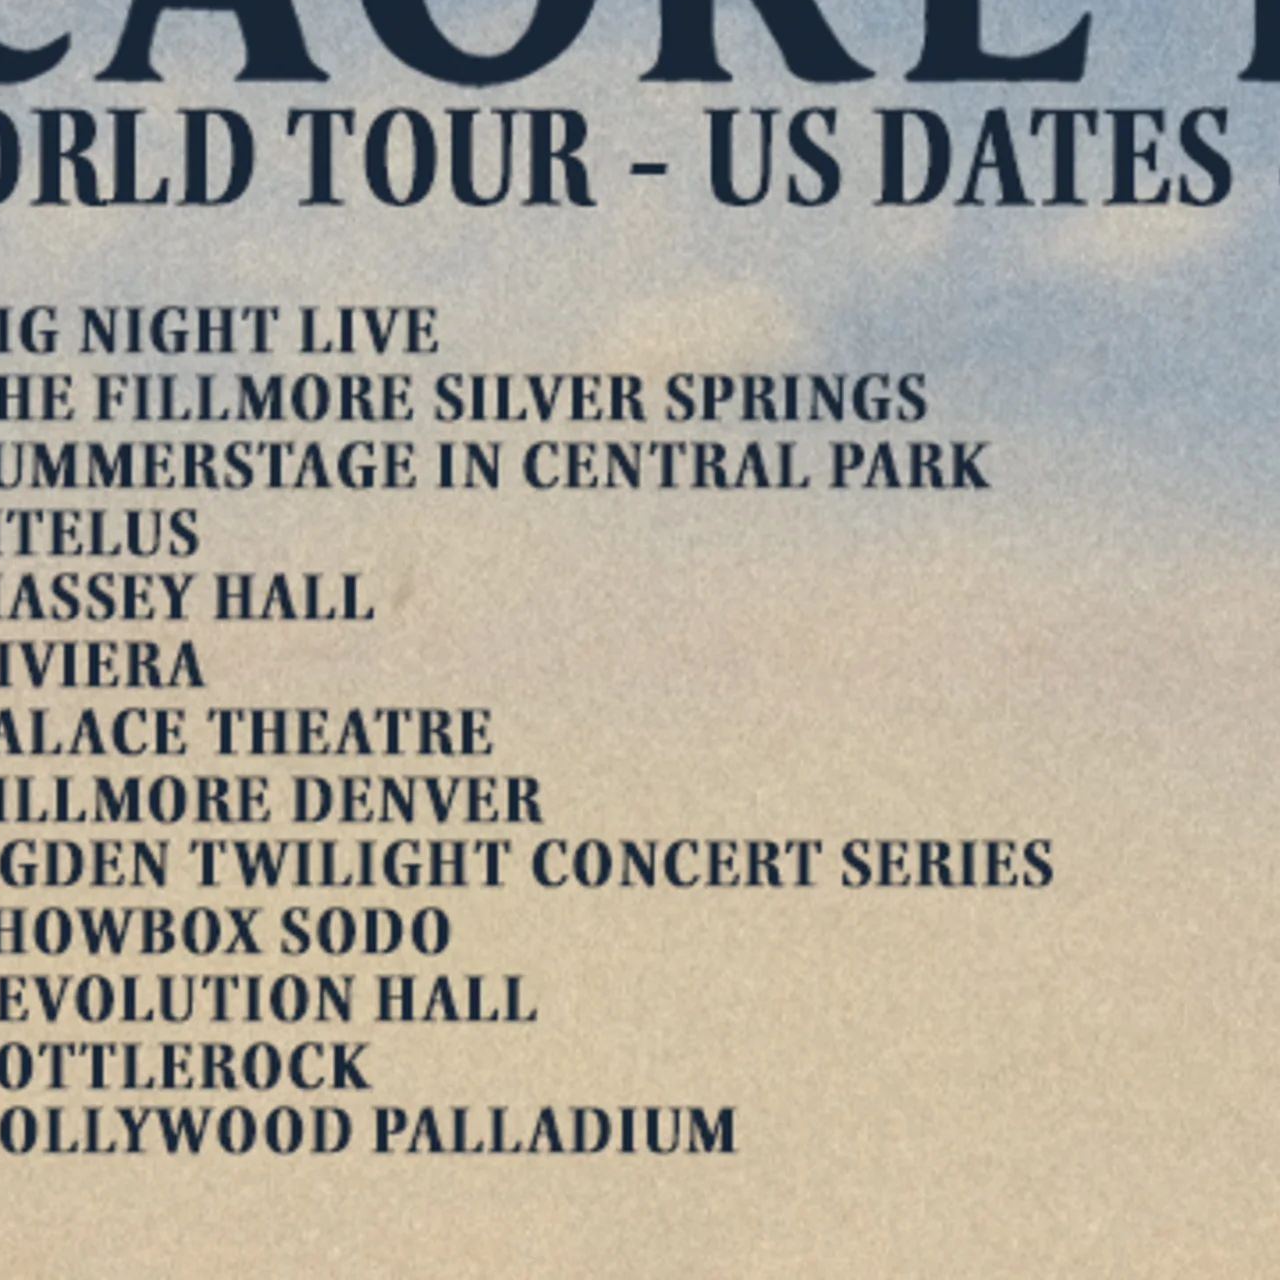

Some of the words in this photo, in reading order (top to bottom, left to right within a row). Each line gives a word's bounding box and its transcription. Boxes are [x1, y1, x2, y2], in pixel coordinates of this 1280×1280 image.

[287, 108, 596, 207] TOUR
[705, 107, 841, 207] US
[875, 107, 1232, 207] DATES
[81, 307, 278, 354] NIGHT
[301, 308, 438, 354] LIVE
[98, 374, 413, 421] FILLMORE
[436, 374, 645, 421] SILVER
[667, 374, 926, 421] SPRINGS
[440, 443, 499, 489] IN
[523, 442, 809, 489] CENTRAL
[832, 442, 989, 489] PARK
[216, 574, 374, 620] HALL
[208, 709, 492, 755] THEATRE
[294, 777, 542, 823] DENVER
[191, 840, 510, 887] TWILIGHT
[532, 840, 822, 887] CONCERT
[842, 840, 1053, 887] SERIES
[282, 908, 449, 954] SODO
[378, 976, 537, 1022] HALL
[375, 1107, 734, 1153] PALLADIUM
